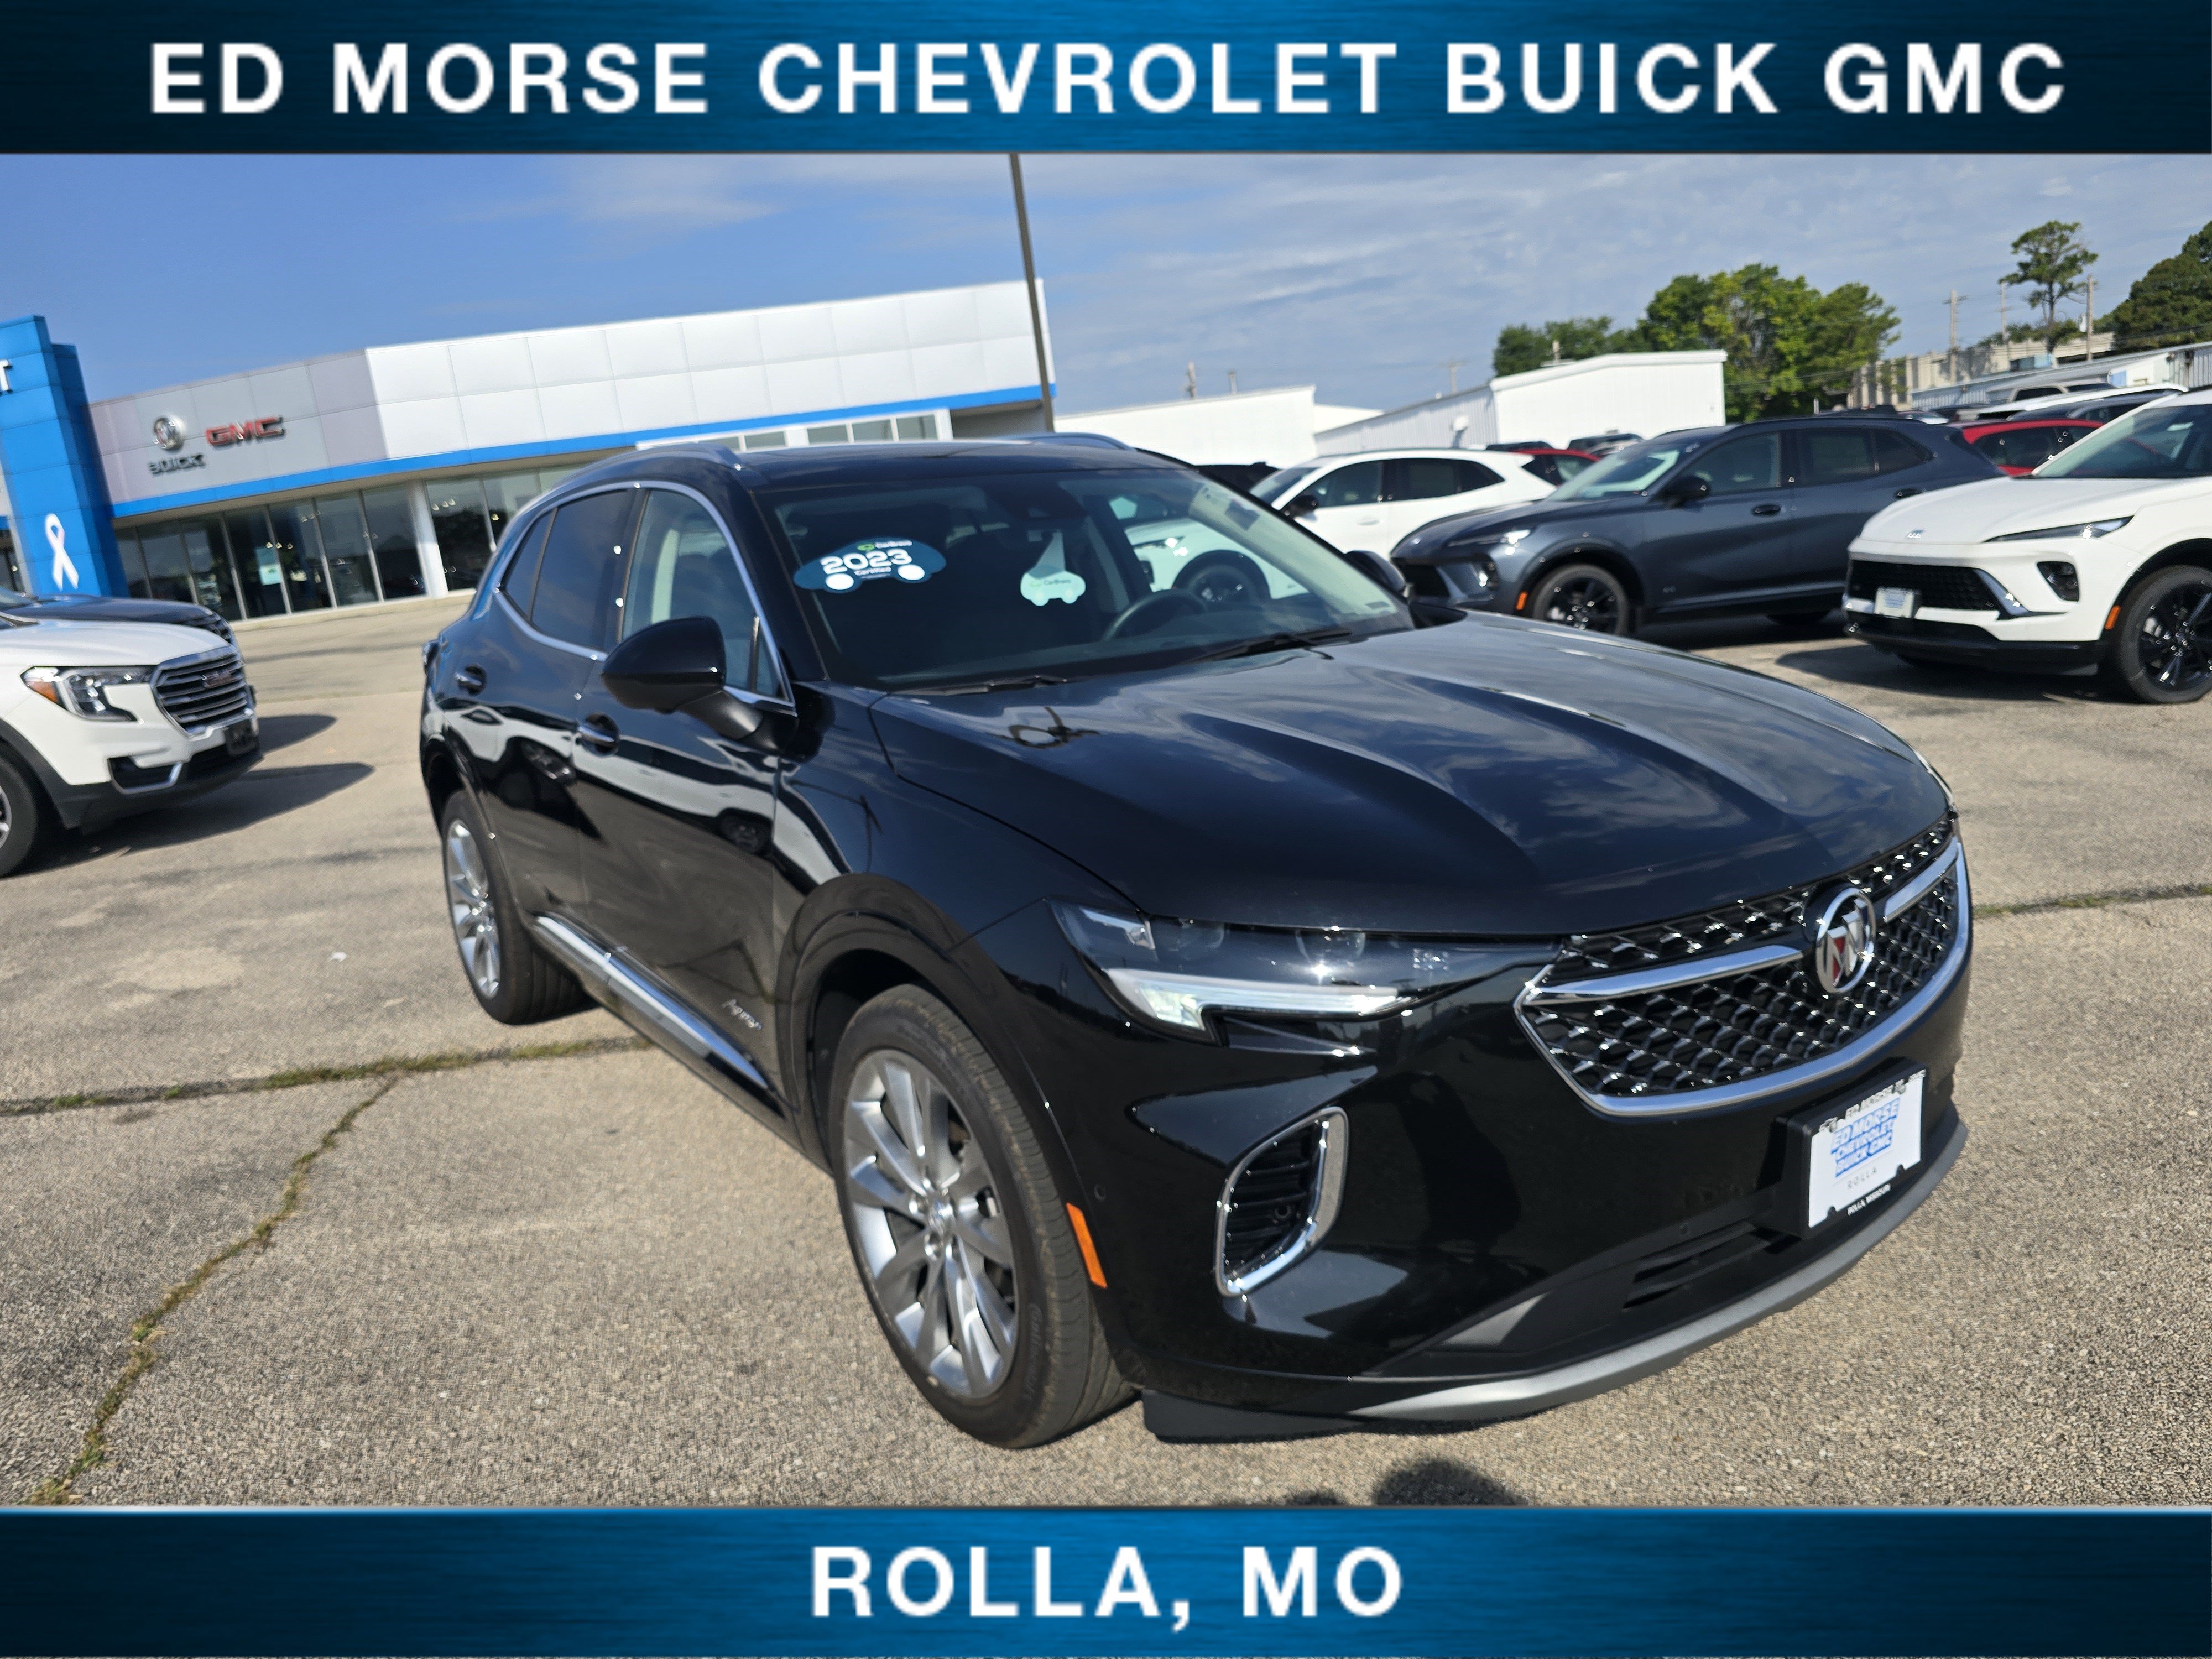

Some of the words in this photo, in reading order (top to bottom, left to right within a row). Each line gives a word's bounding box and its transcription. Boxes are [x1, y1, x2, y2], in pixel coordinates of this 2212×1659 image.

[205, 416, 285, 448] GMC
[149, 454, 206, 475] BUICK
[820, 548, 912, 575] 2023
[1832, 1125, 1853, 1151] ED
[1852, 1097, 1901, 1136] MORSE
[1847, 1167, 1877, 1189] ROLLA
